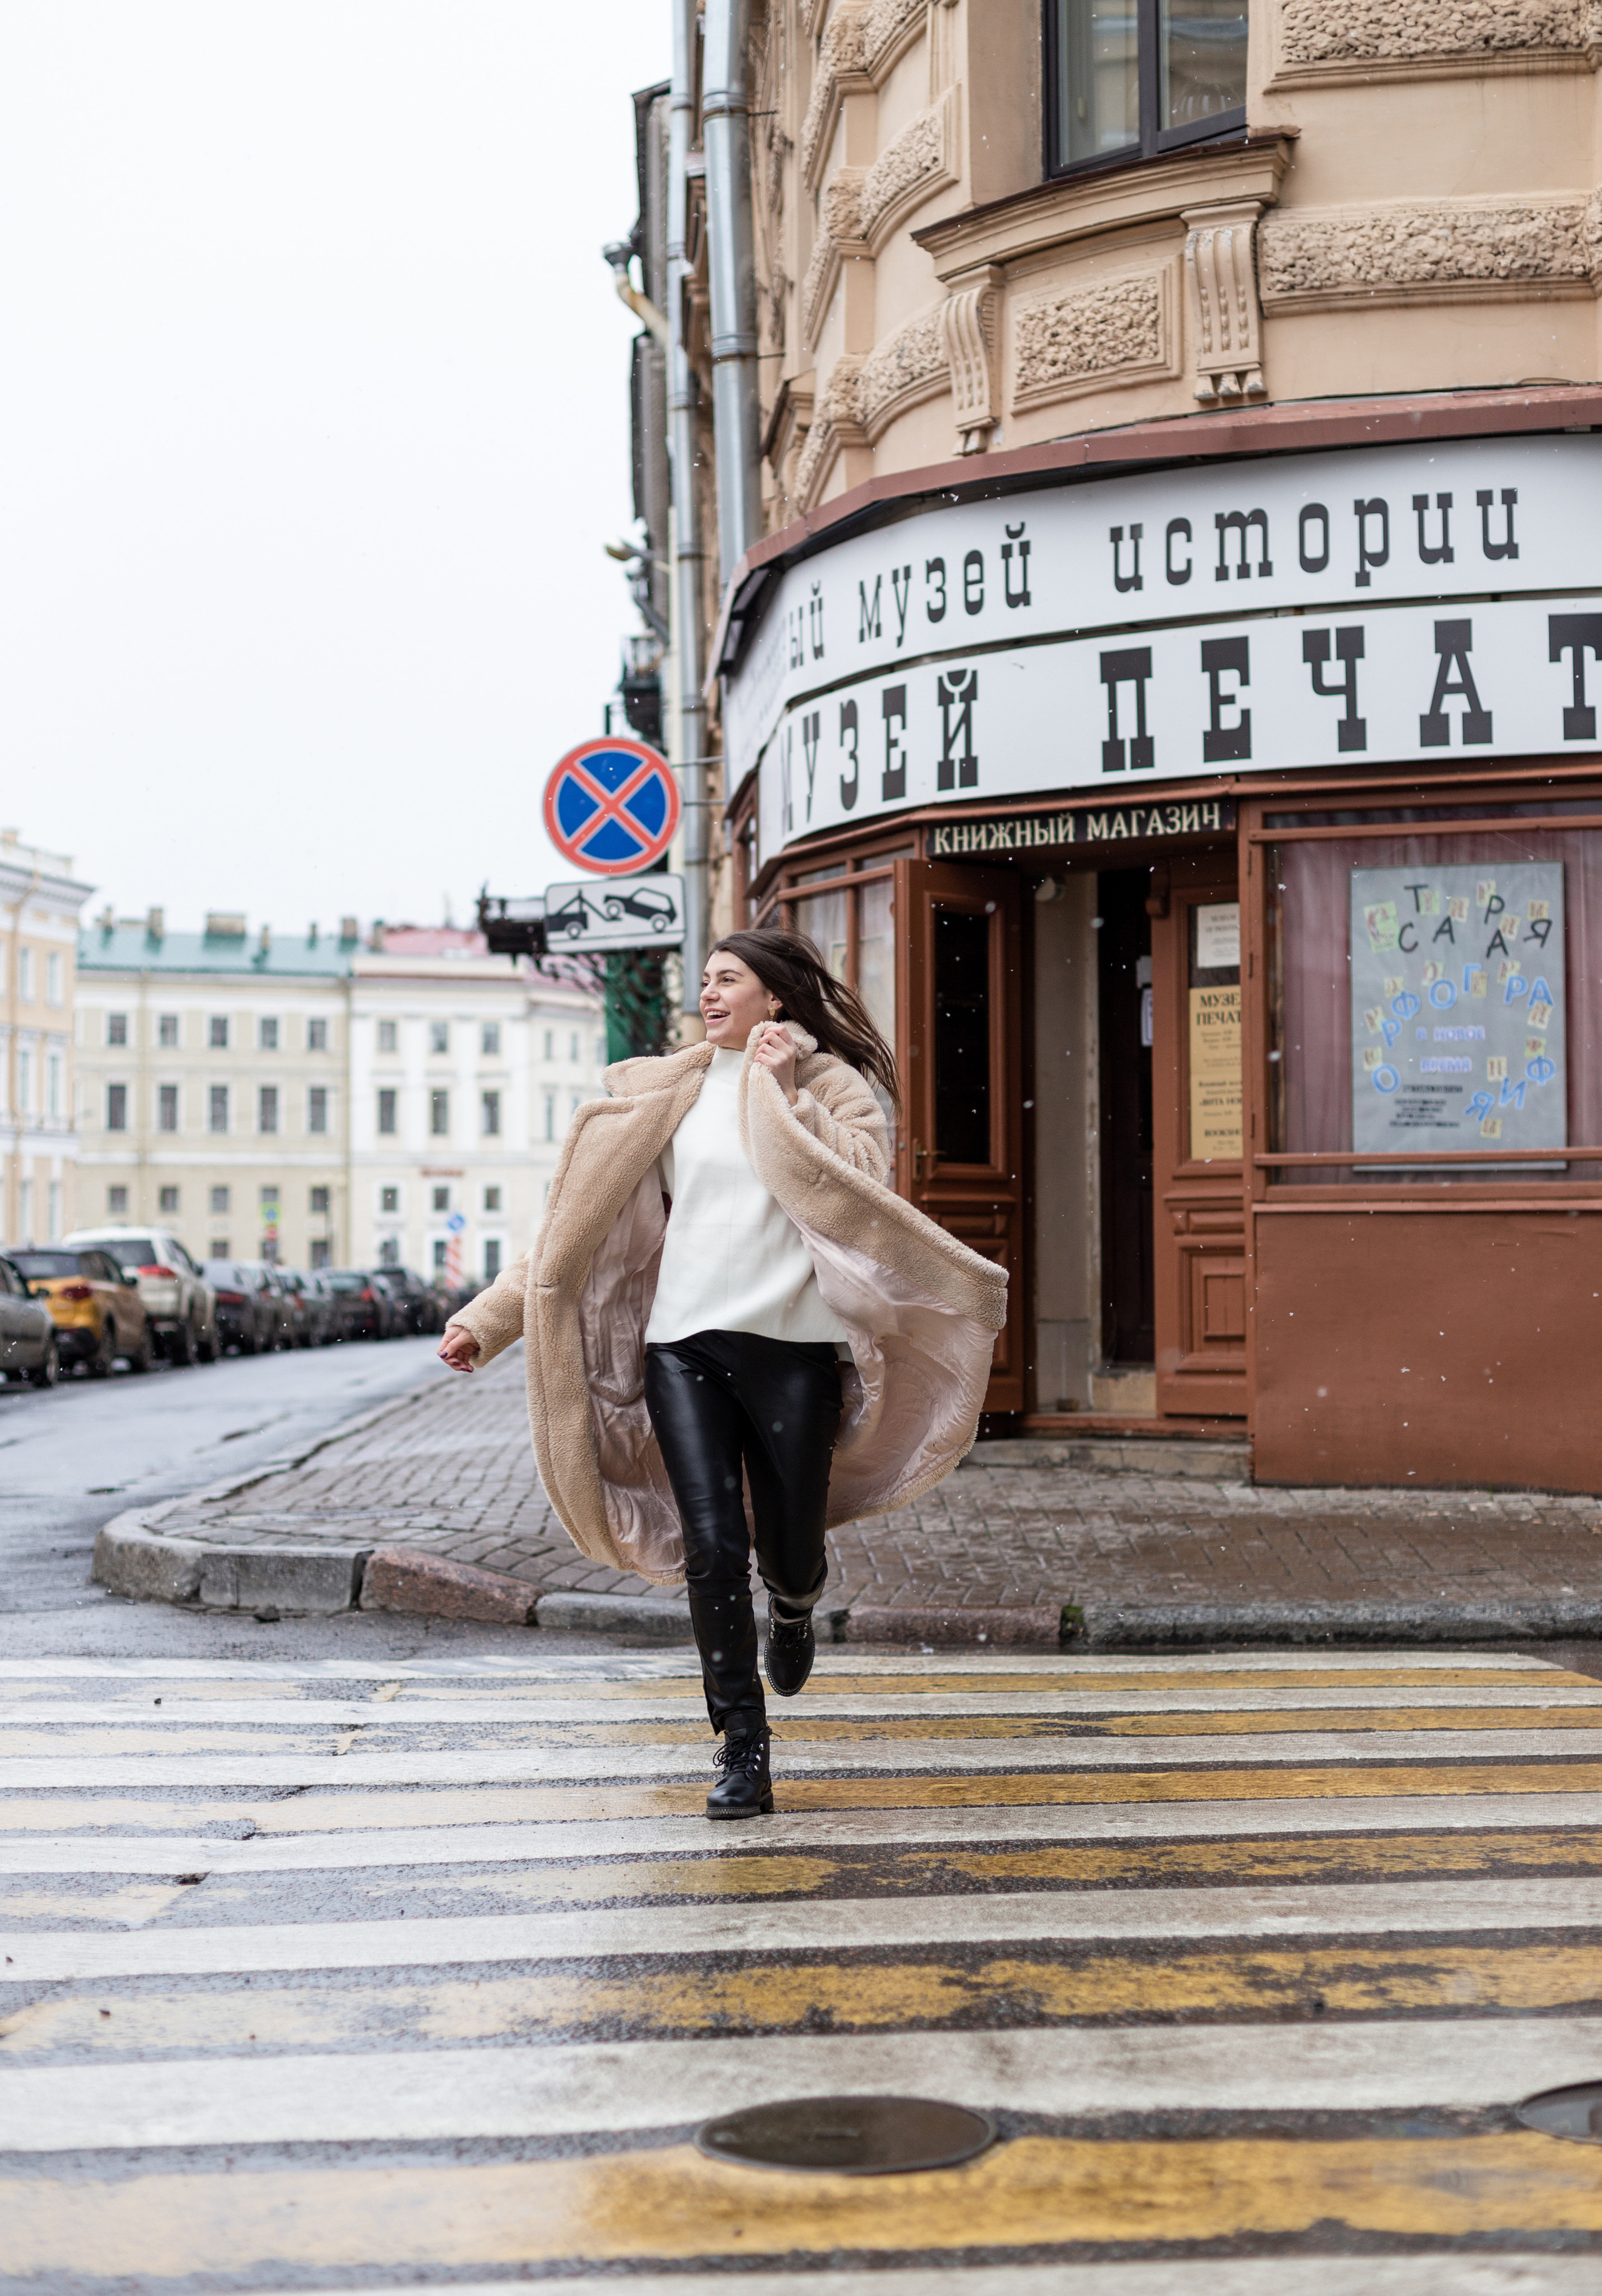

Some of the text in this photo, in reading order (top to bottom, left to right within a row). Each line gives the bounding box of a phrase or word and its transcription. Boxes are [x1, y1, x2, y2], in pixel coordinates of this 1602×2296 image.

[859, 521, 1031, 647] музей
[1110, 487, 1519, 593] истории
[1099, 613, 1602, 773] ПЕЧАТ
[934, 812, 1075, 854] КНИЖНЫЙ
